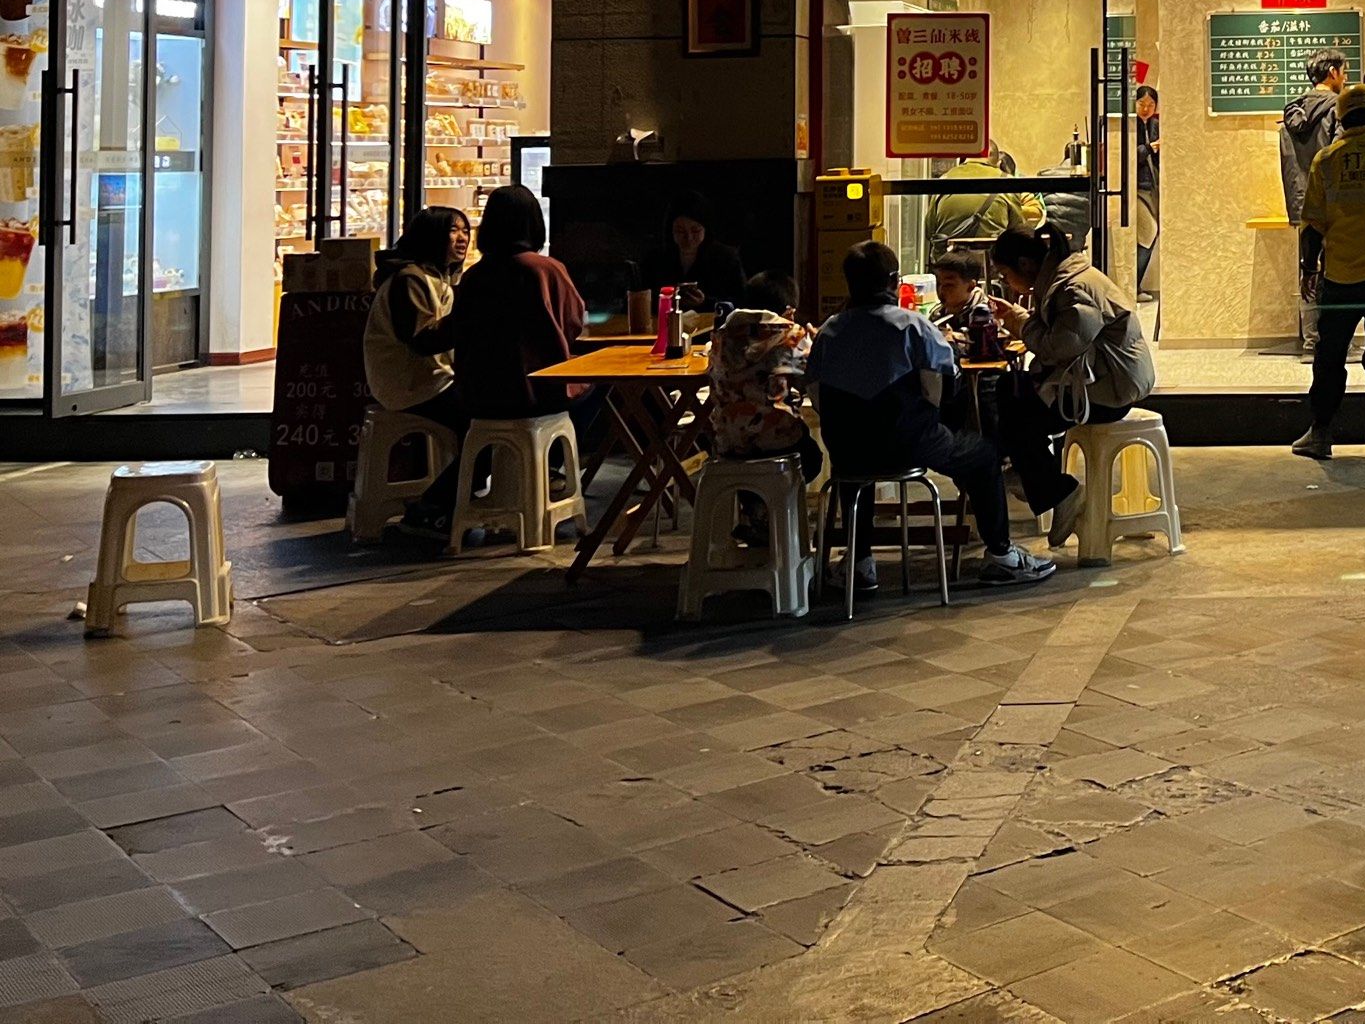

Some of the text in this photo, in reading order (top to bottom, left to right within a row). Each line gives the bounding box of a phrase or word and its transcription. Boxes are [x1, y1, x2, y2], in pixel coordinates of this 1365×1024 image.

[896, 27, 981, 44] 曾三仙米线
[1259, 20, 1311, 33] 番茄/滋补
[912, 56, 962, 79] 招聘
[291, 294, 371, 319] ANDRS
[286, 382, 336, 398] 200元
[276, 424, 339, 446] 240元
